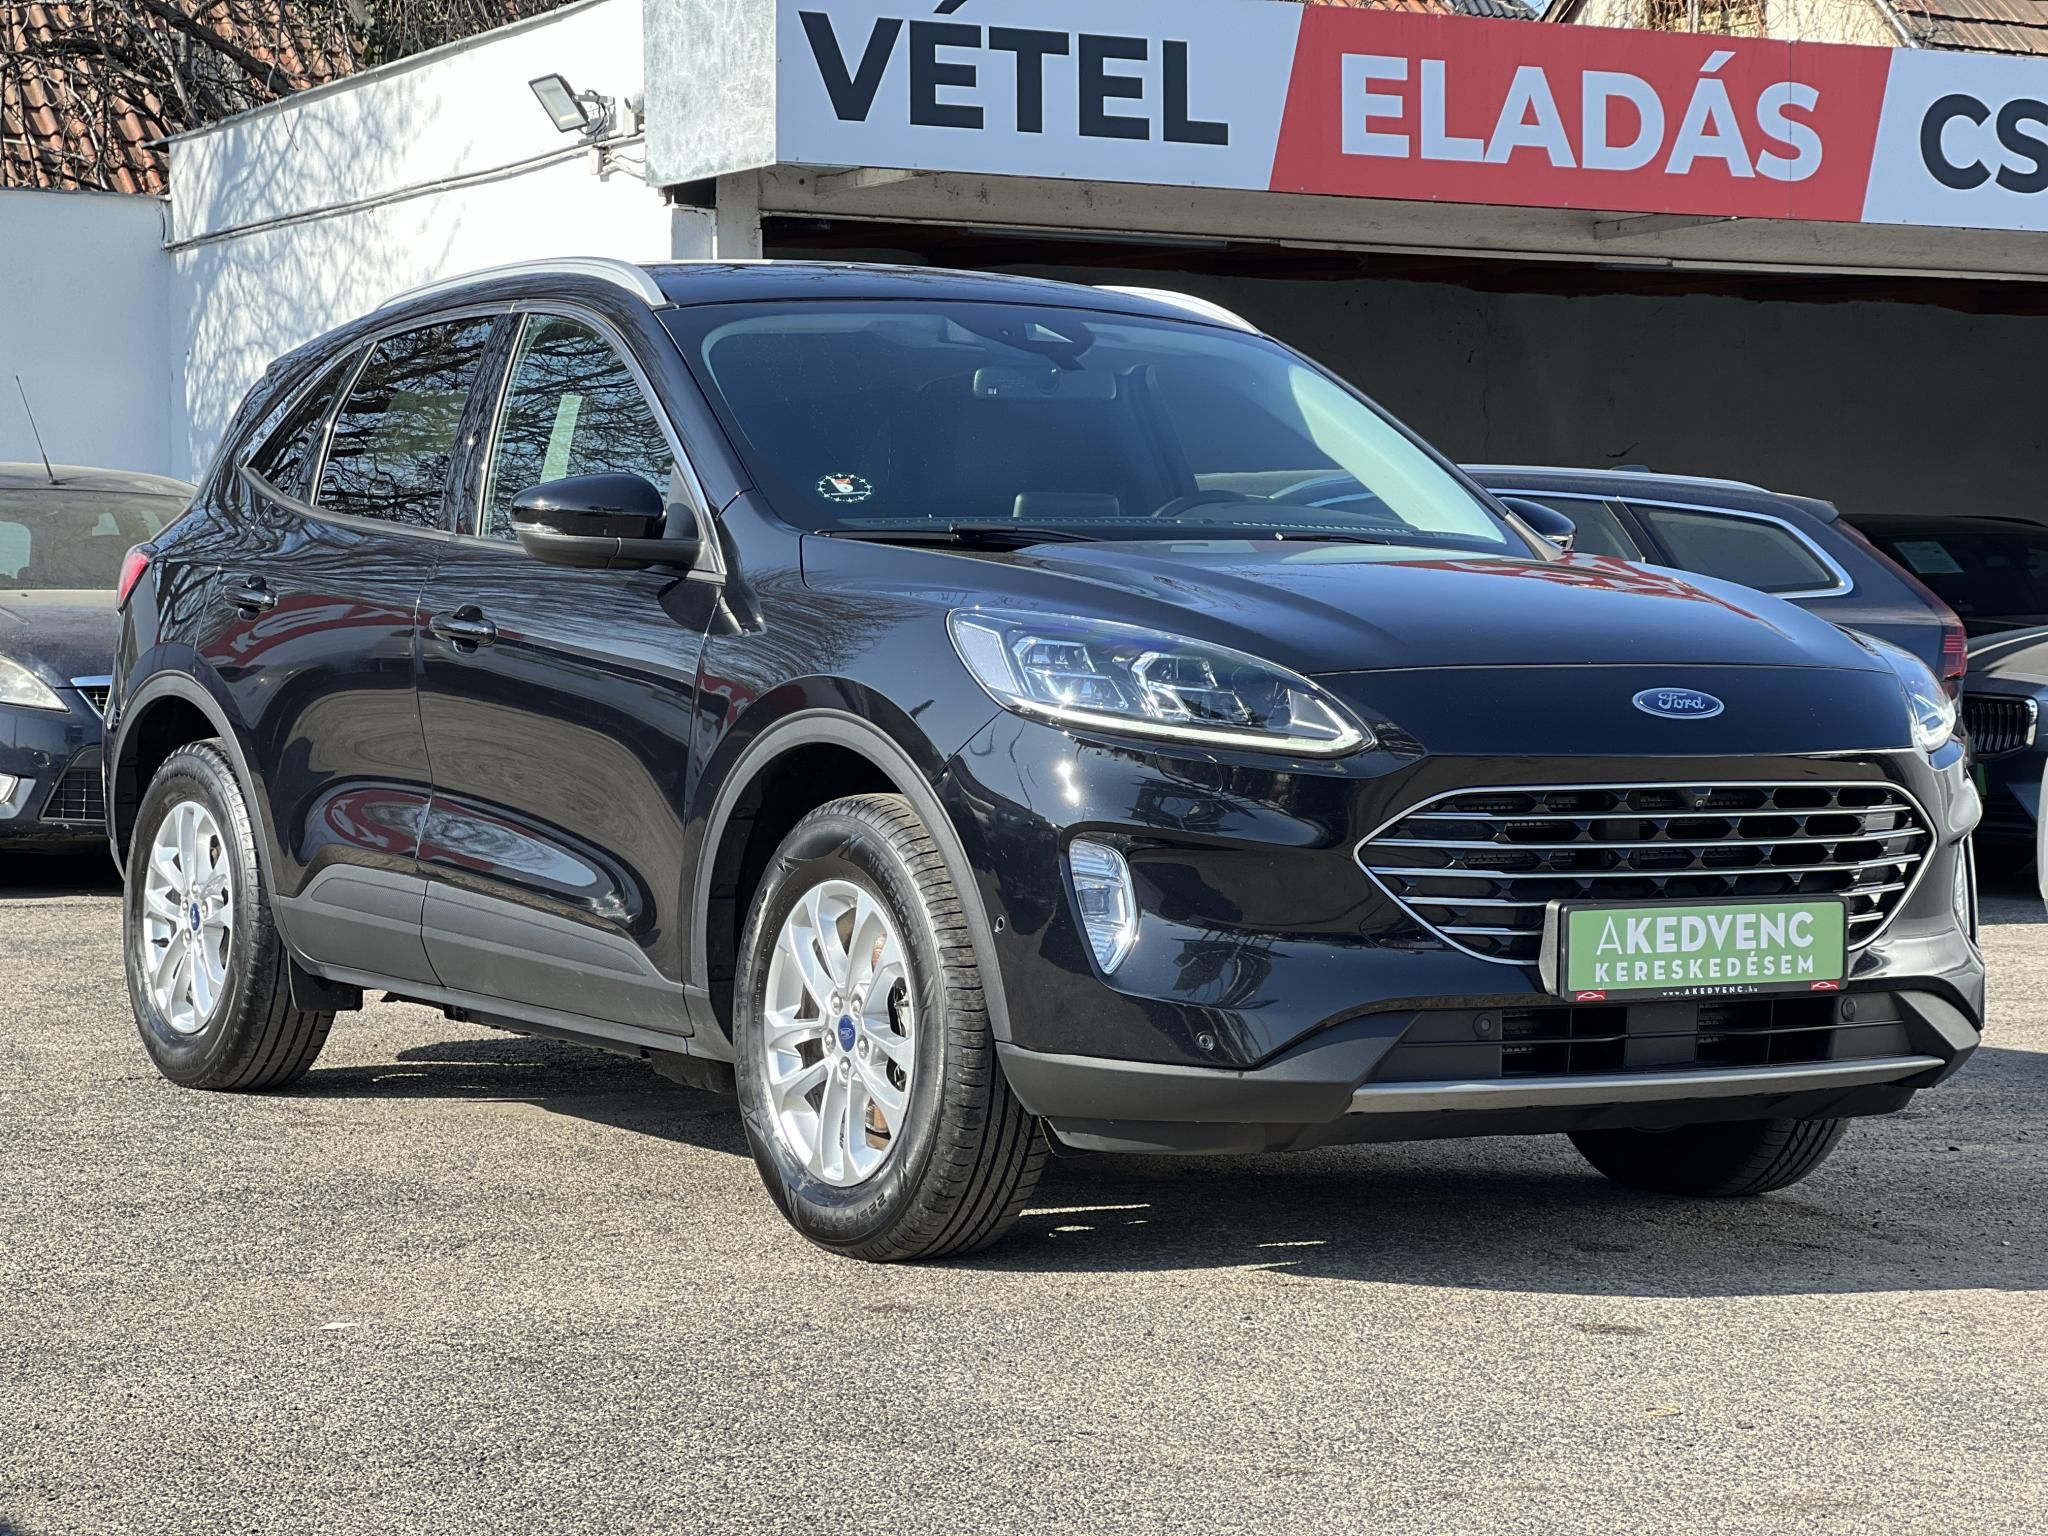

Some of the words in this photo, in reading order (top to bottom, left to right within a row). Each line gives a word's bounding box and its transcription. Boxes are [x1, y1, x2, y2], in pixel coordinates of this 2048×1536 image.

[799, 0, 1229, 146] VÉTEL
[1341, 50, 1823, 182] ELADÁS
[1919, 93, 2048, 193] CS
[1658, 692, 1706, 709] Ford
[1595, 951, 1814, 983] KERESKEDÉSEM
[1596, 911, 1815, 955] AKEDVENC
